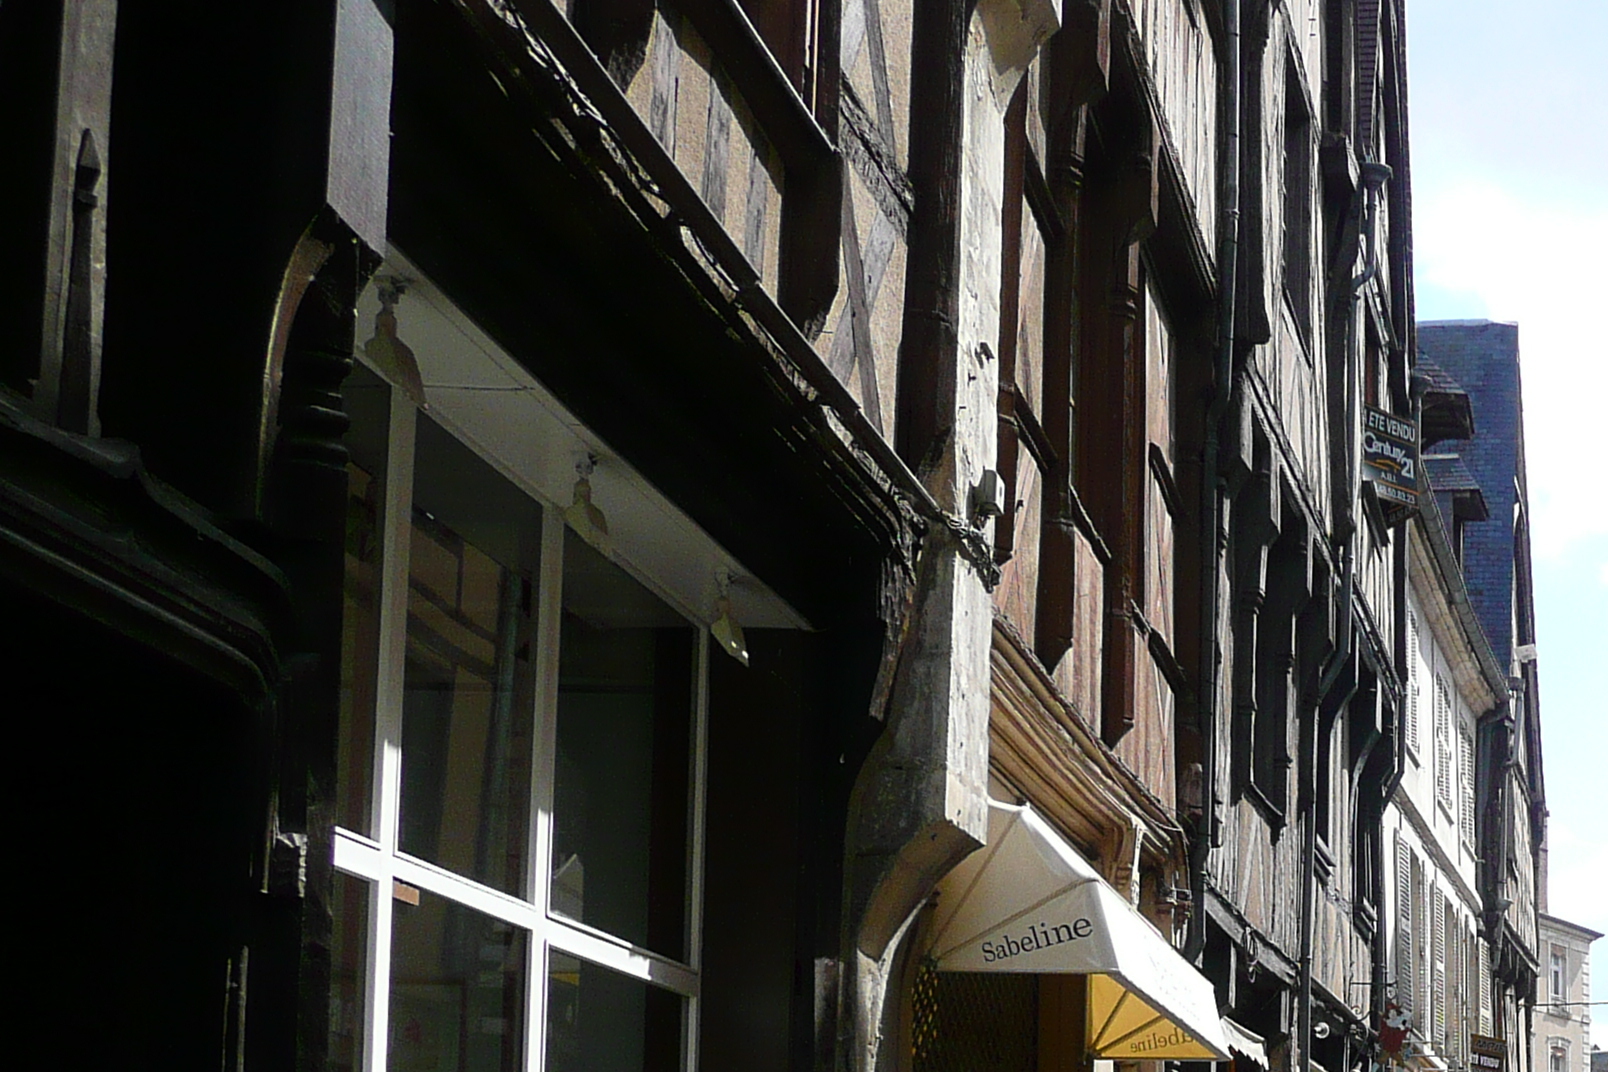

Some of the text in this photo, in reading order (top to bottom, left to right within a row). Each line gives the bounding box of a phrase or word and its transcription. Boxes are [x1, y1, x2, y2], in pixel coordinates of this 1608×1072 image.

[1387, 419, 1416, 442] VENDU
[1362, 431, 1415, 480] Century 21
[981, 918, 1094, 963] Sabeline
